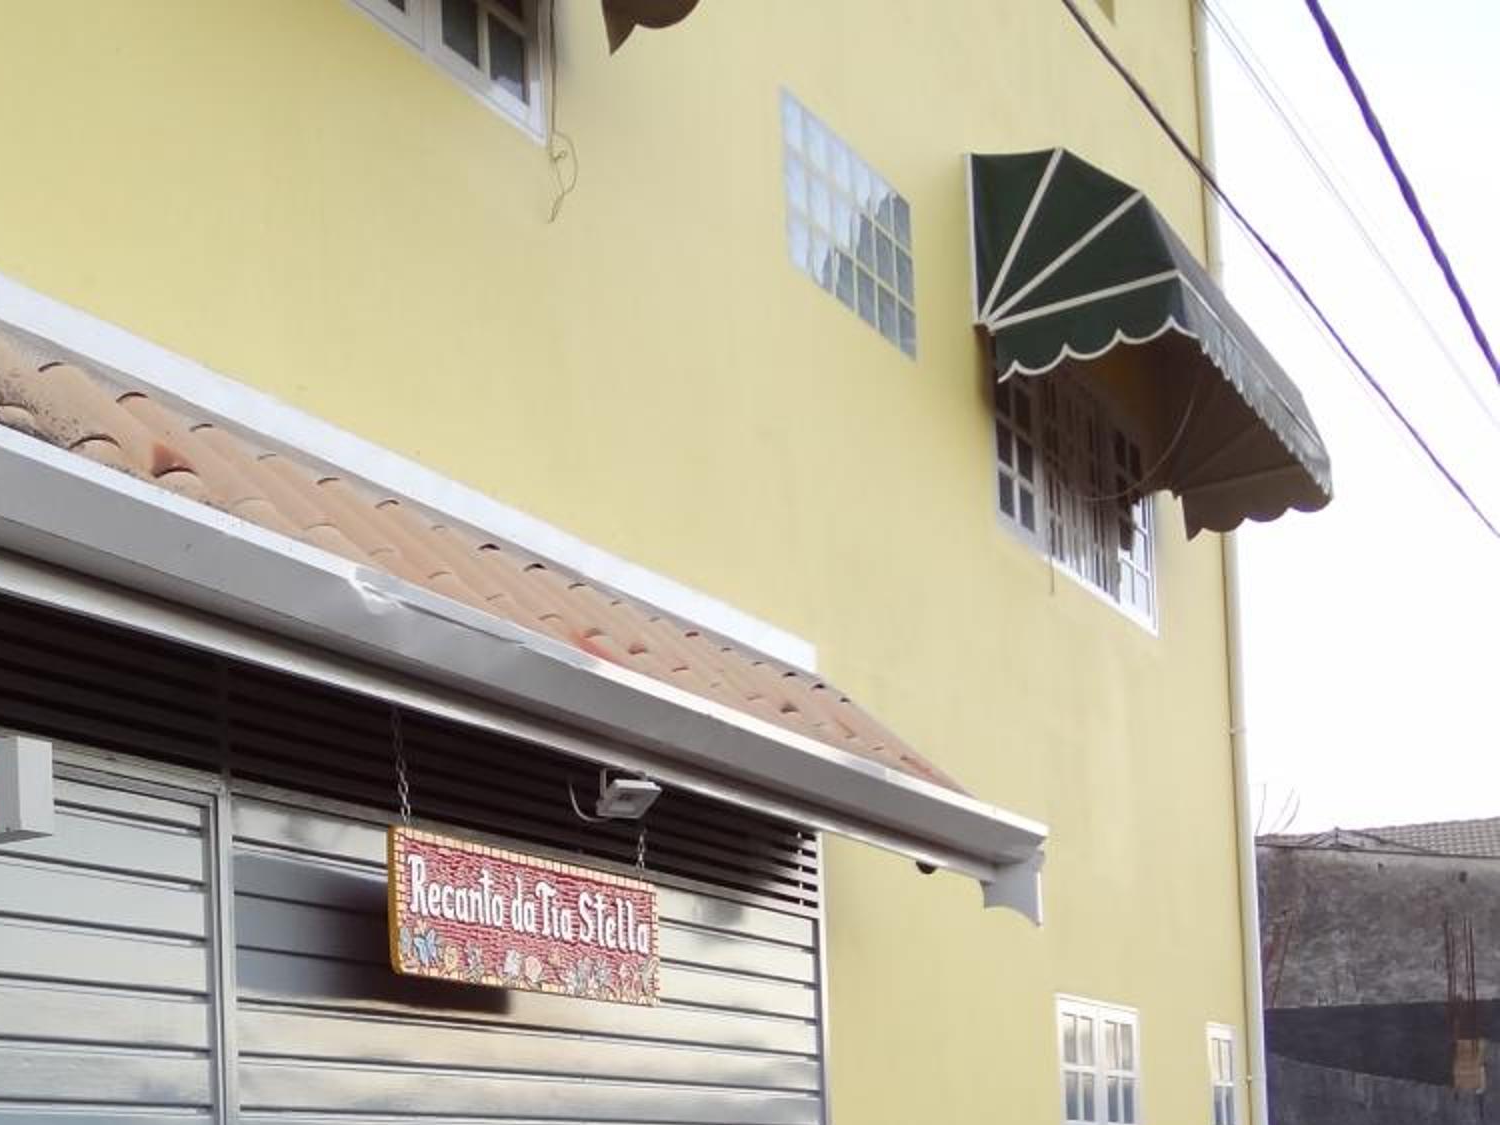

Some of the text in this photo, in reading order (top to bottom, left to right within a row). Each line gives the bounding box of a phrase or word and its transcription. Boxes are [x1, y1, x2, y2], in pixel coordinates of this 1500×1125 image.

[408, 854, 650, 954] Recanto da Tia Stella
